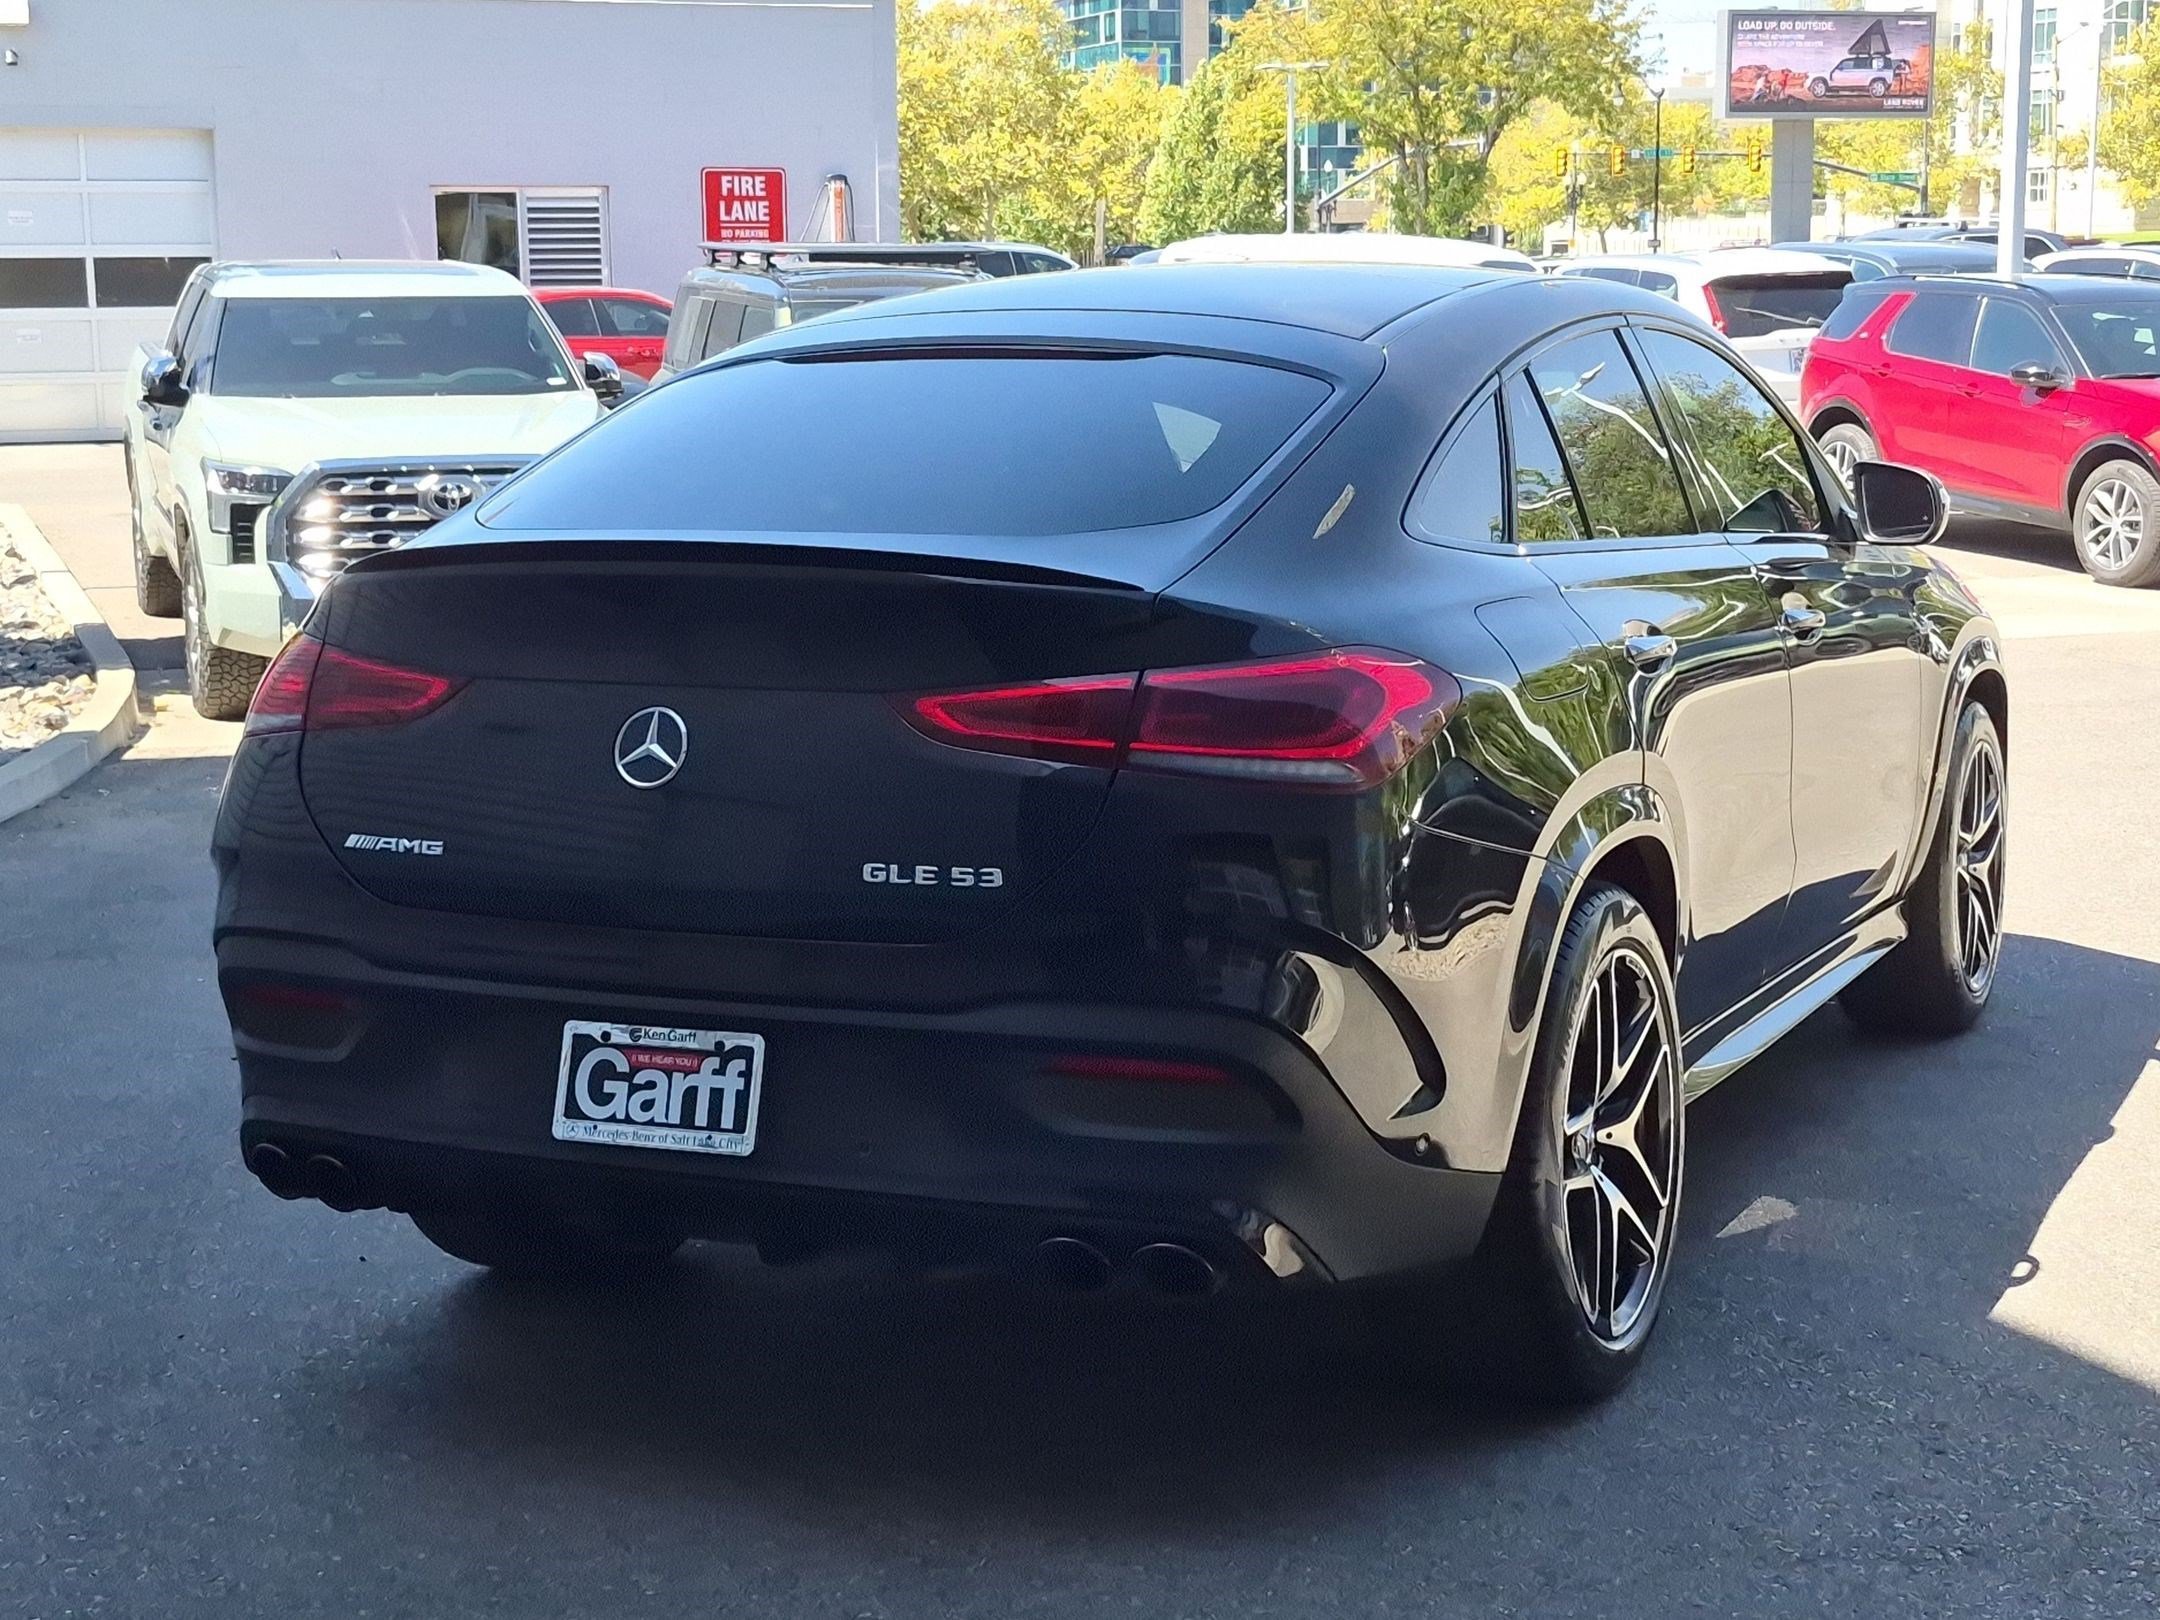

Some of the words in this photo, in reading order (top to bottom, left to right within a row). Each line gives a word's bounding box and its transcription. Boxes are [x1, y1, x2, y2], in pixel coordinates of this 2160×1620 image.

[1738, 21, 1762, 31] LOAD
[721, 175, 767, 197] FIRE
[719, 200, 770, 222] LANE
[720, 228, 733, 239] NO
[734, 228, 770, 239] PARKING
[374, 837, 444, 855] AMG
[862, 863, 939, 885] GLE
[950, 866, 1003, 888] 53
[652, 1055, 675, 1065] HEAR
[675, 1057, 692, 1067] YOU
[575, 1047, 747, 1130] Garff
[658, 1132, 668, 1143] of
